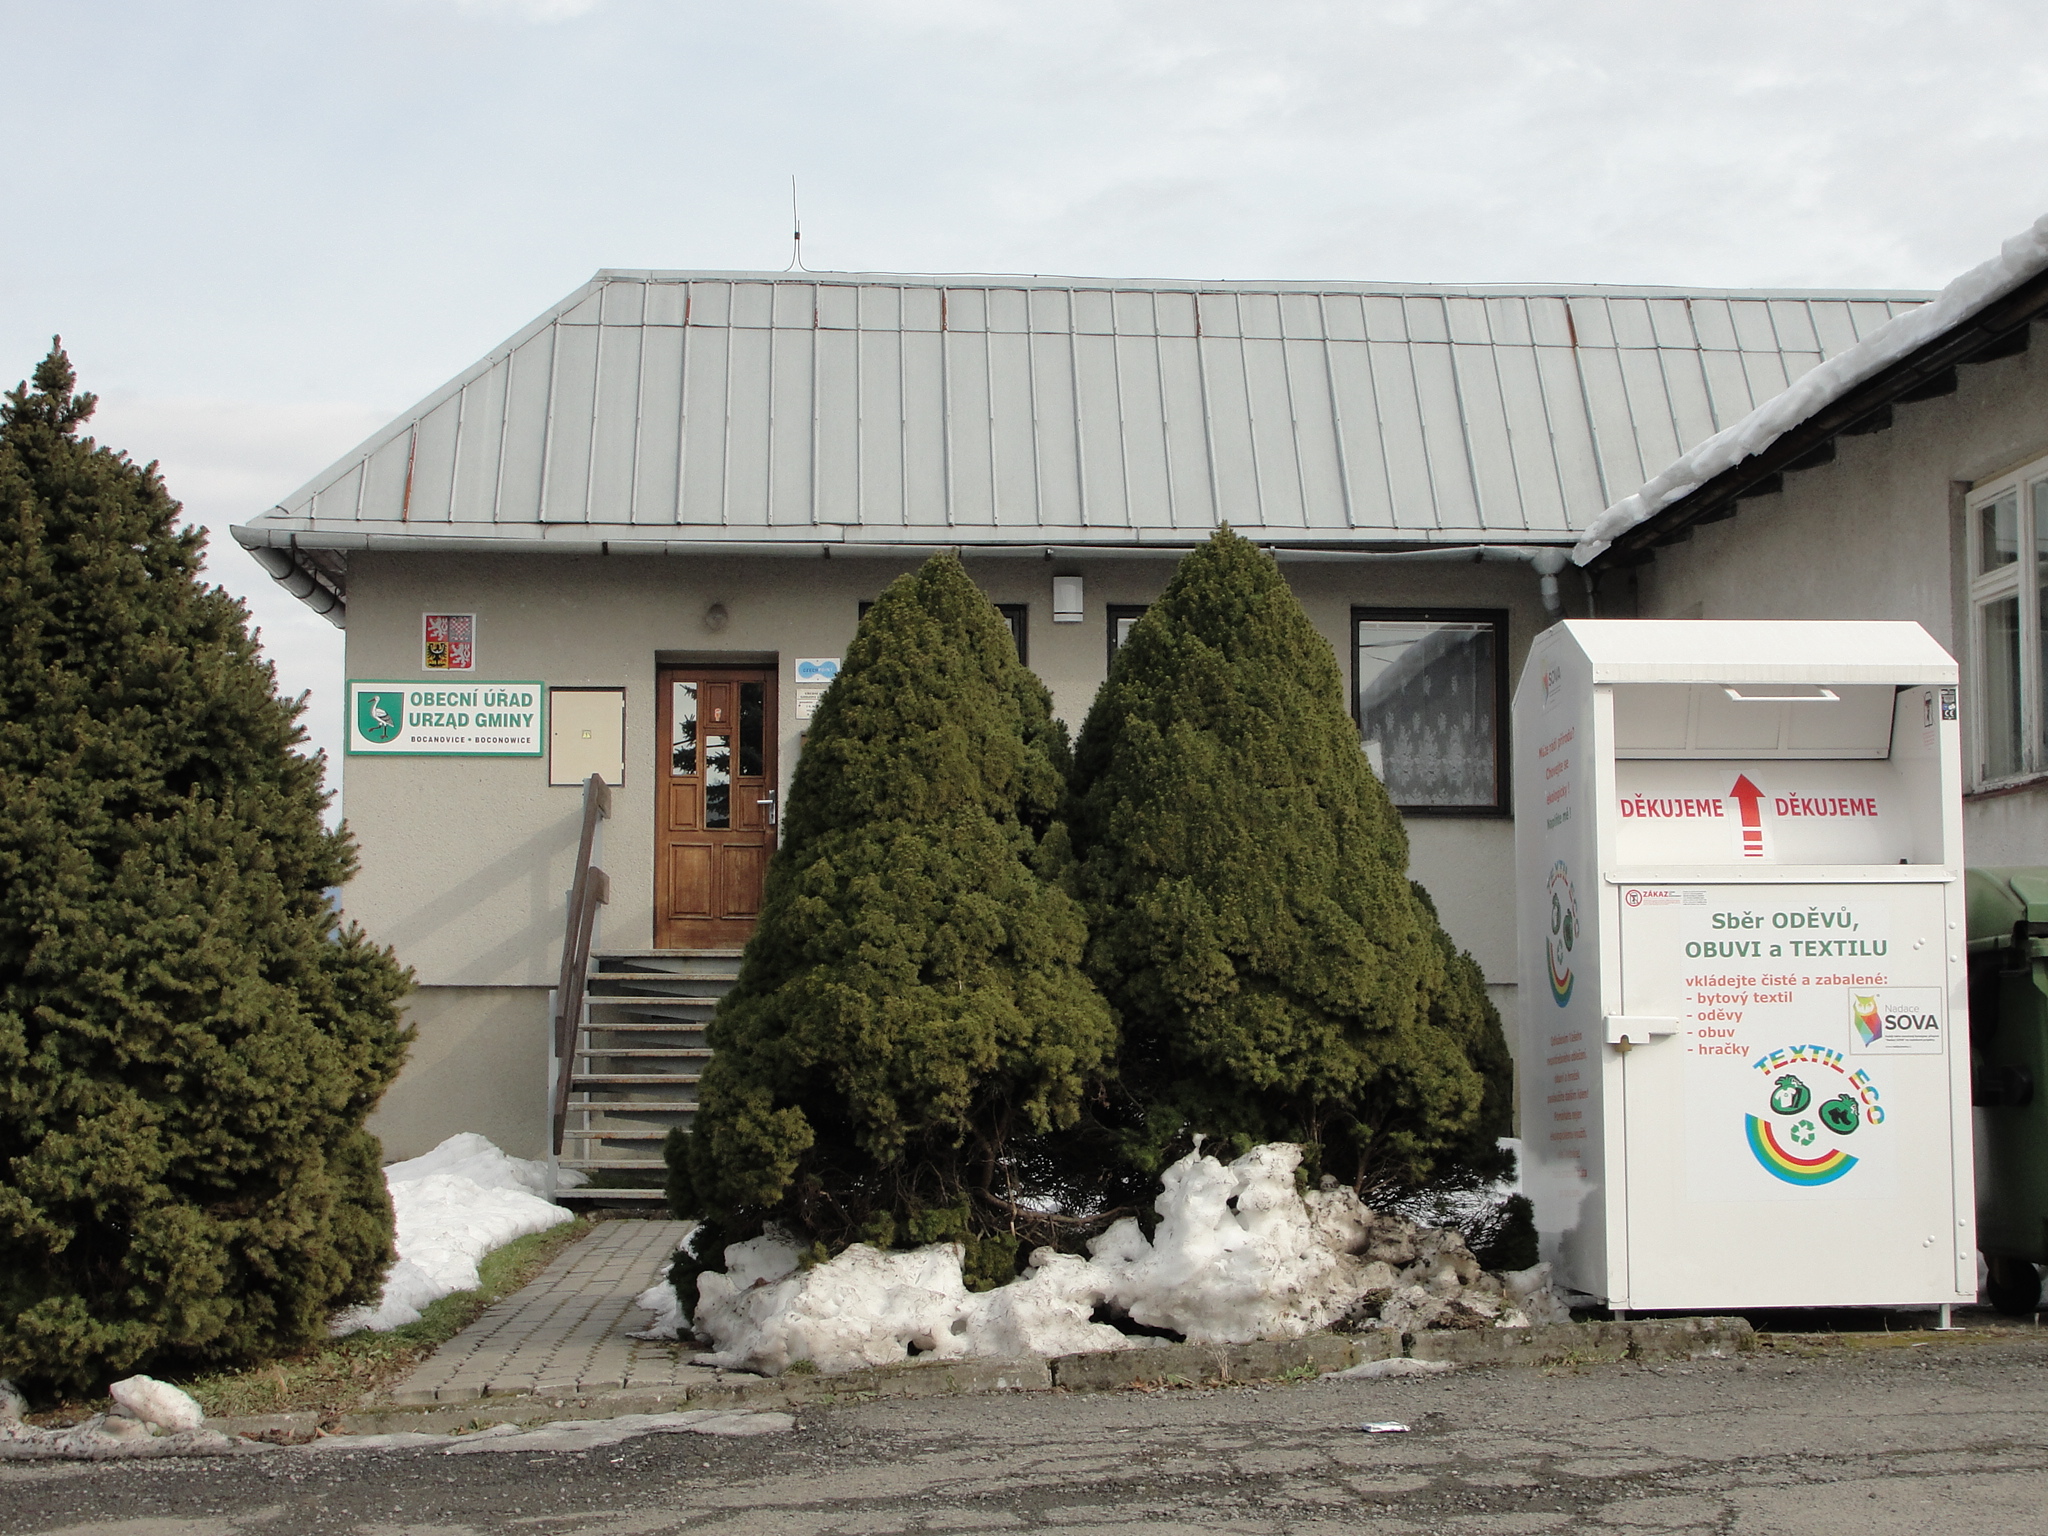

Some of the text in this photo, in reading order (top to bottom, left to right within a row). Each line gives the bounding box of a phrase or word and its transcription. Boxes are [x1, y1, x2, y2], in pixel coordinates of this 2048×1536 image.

[410, 688, 533, 707] OBECNÍ ÚŘAD
[408, 712, 535, 729] URZĄD GMINY
[410, 736, 531, 744] BOCANOVICE BOCONOWICE
[1620, 792, 1878, 818] DĚKUJEME DĚKUJEME
[1642, 890, 1669, 898] ZÁKAZ
[1711, 906, 1859, 932] Sběr ODĚVŮ,
[1685, 940, 1888, 958] OBUVI a TEXTILU
[1685, 972, 1888, 989] vkládejte čisté a zabalené:
[1697, 991, 1748, 1006] bytový
[1753, 991, 1793, 1003] textil
[1697, 1008, 1743, 1023] oděvy
[1884, 1004, 1920, 1013] Nadace
[1884, 1014, 1939, 1030] SOVA
[1698, 1026, 1735, 1039] obuv
[1698, 1043, 1750, 1057] hračky
[1752, 1044, 1885, 1125] TEXTIL ECO
